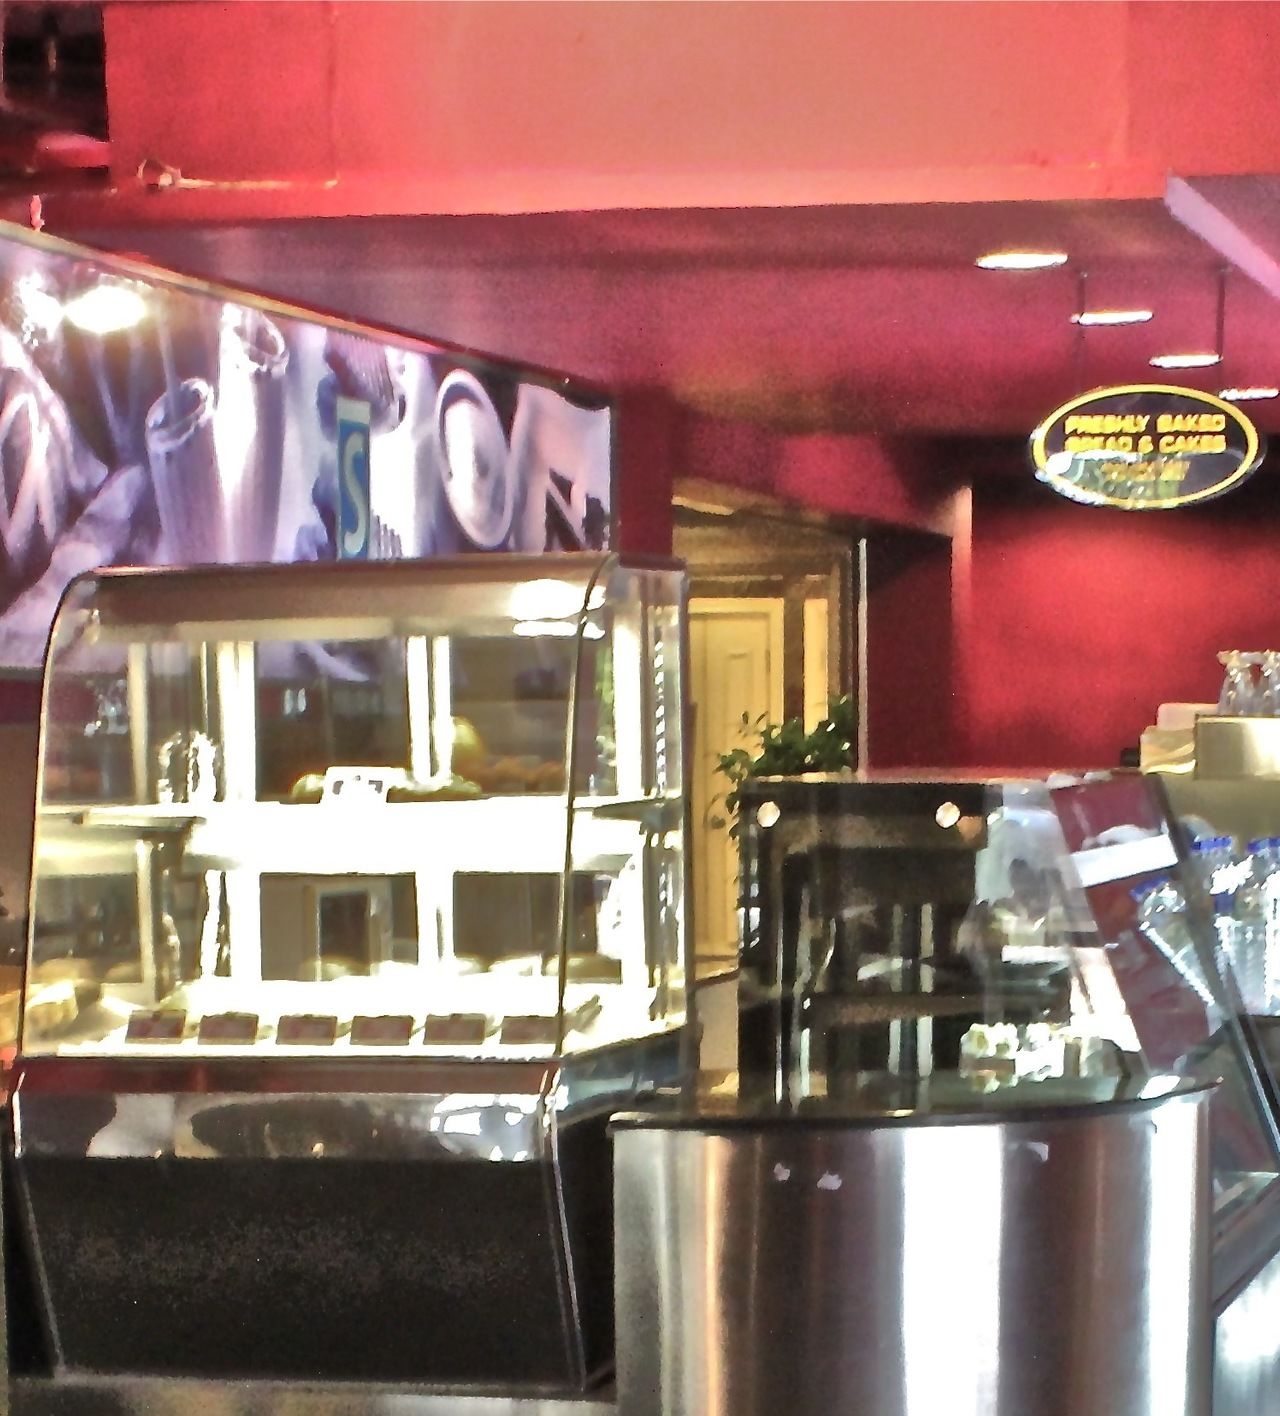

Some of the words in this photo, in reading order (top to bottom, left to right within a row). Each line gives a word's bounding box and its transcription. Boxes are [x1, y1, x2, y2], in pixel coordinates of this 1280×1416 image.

[1156, 413, 1226, 434] BAKED
[1138, 435, 1154, 454] &
[1159, 435, 1227, 454] CAKES
